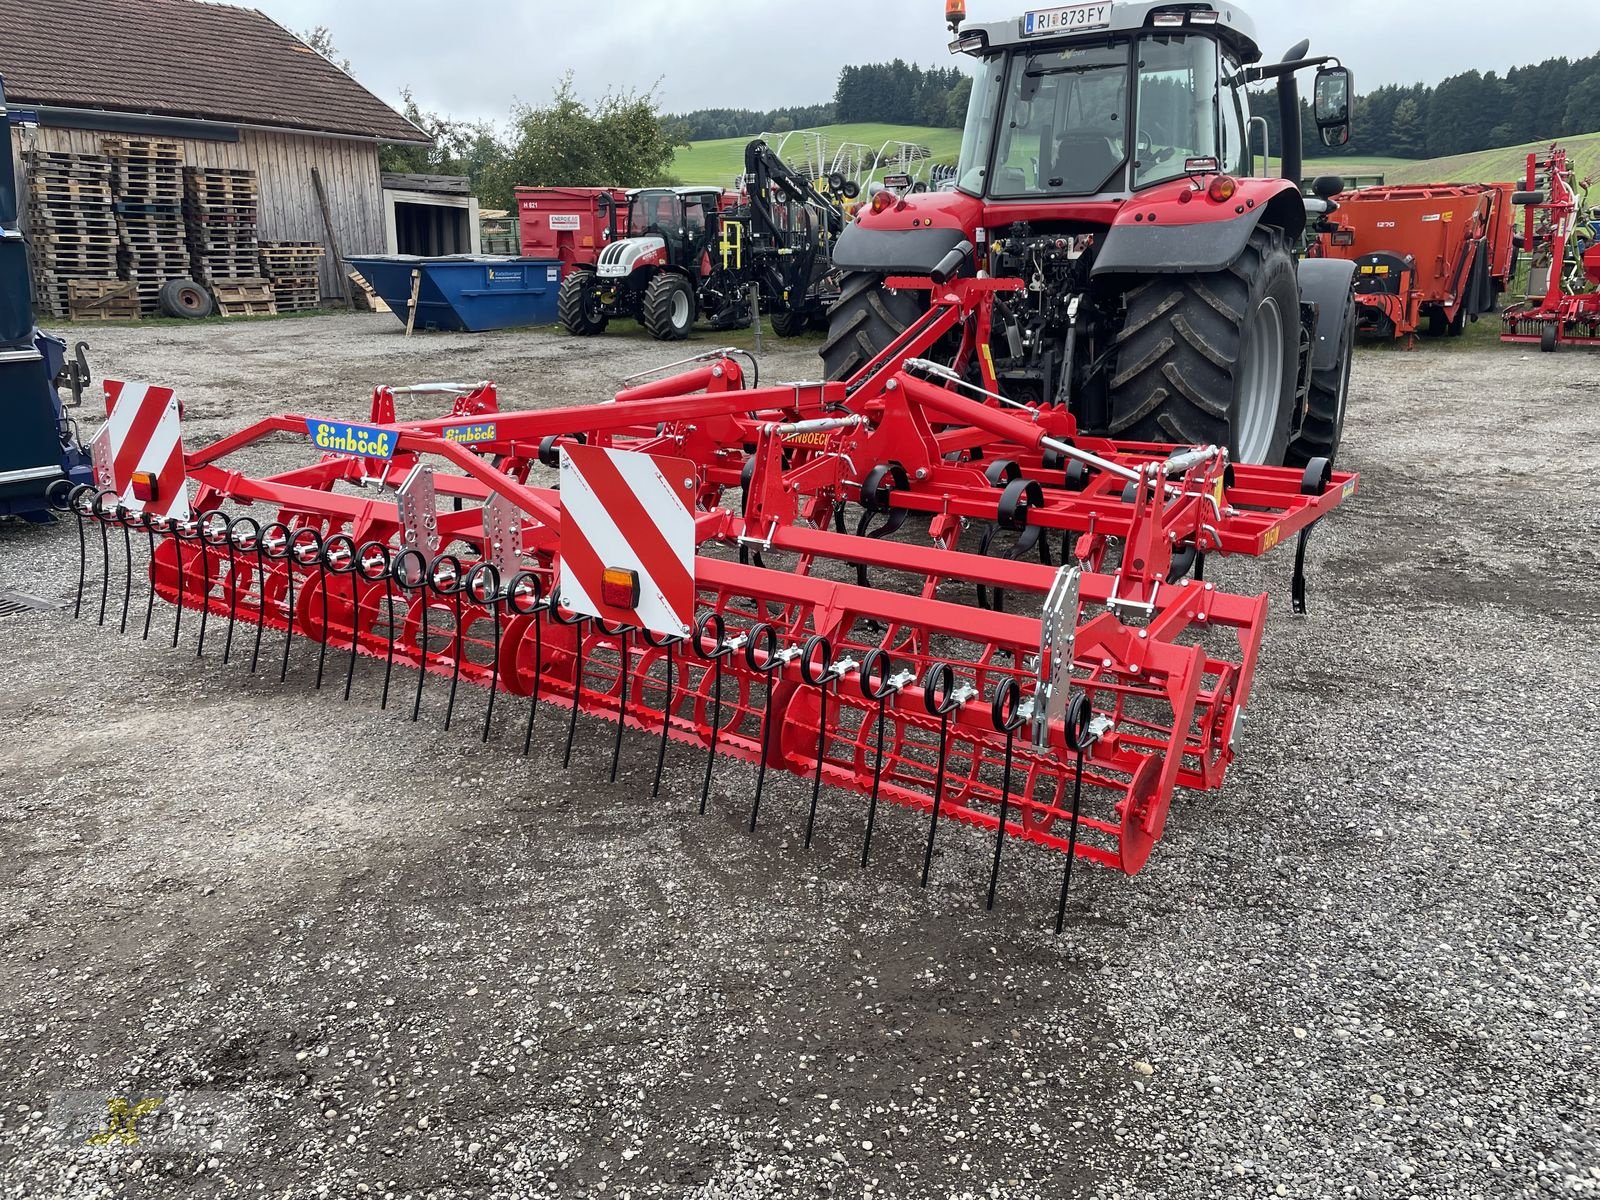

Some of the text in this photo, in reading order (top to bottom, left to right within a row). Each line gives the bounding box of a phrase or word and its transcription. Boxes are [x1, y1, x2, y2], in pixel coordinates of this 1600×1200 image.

[1038, 14, 1051, 29] RI
[316, 424, 389, 457] Einböck
[445, 427, 495, 443] Einböck
